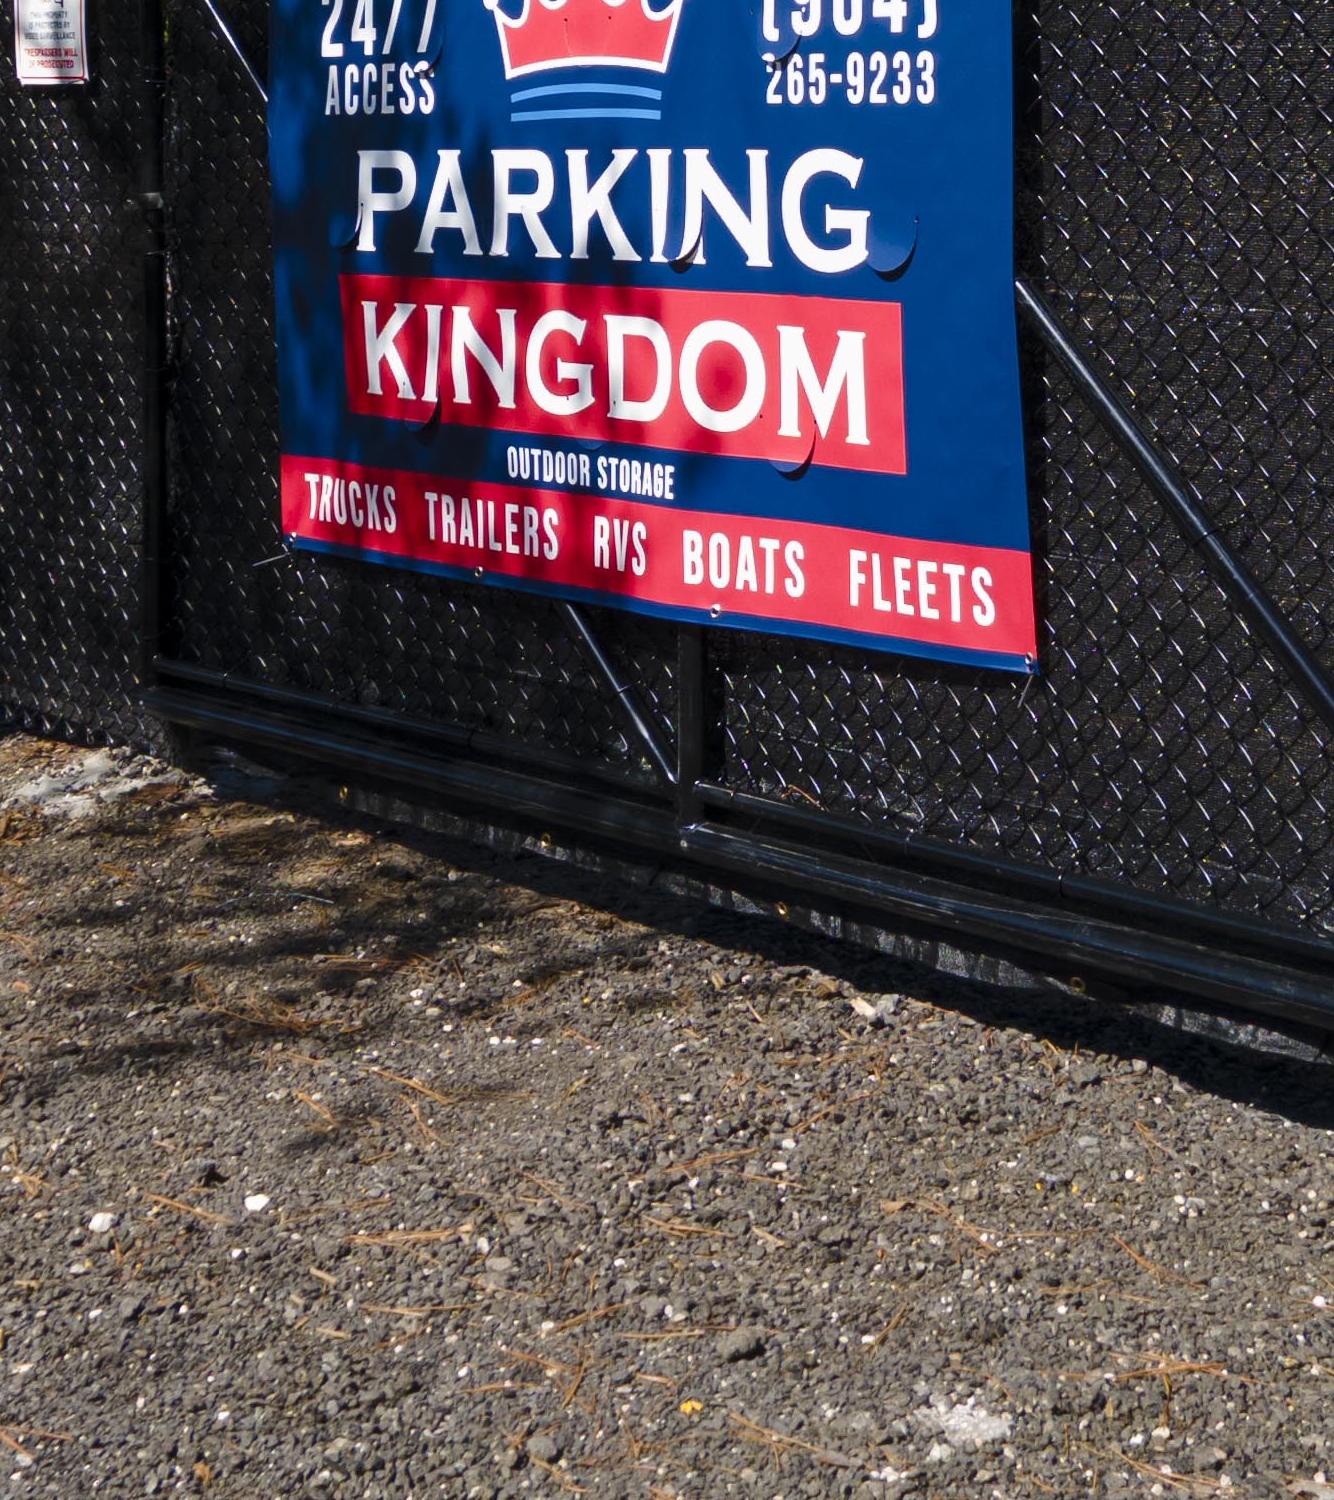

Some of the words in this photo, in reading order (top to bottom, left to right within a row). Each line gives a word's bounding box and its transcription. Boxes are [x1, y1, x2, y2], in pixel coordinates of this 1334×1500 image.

[324, 60, 435, 116] ACCESS
[761, 50, 935, 105] 265-9233
[354, 147, 871, 274] PARKING
[360, 299, 872, 447] KINGDOM
[506, 445, 591, 488] OUTDOOR
[597, 455, 676, 501] STORAGE
[303, 472, 398, 534] TRUCKS
[423, 491, 560, 561] TRAILERS
[593, 515, 648, 577] RVS
[682, 528, 806, 599] BOATS
[848, 548, 997, 627] FLEETS
